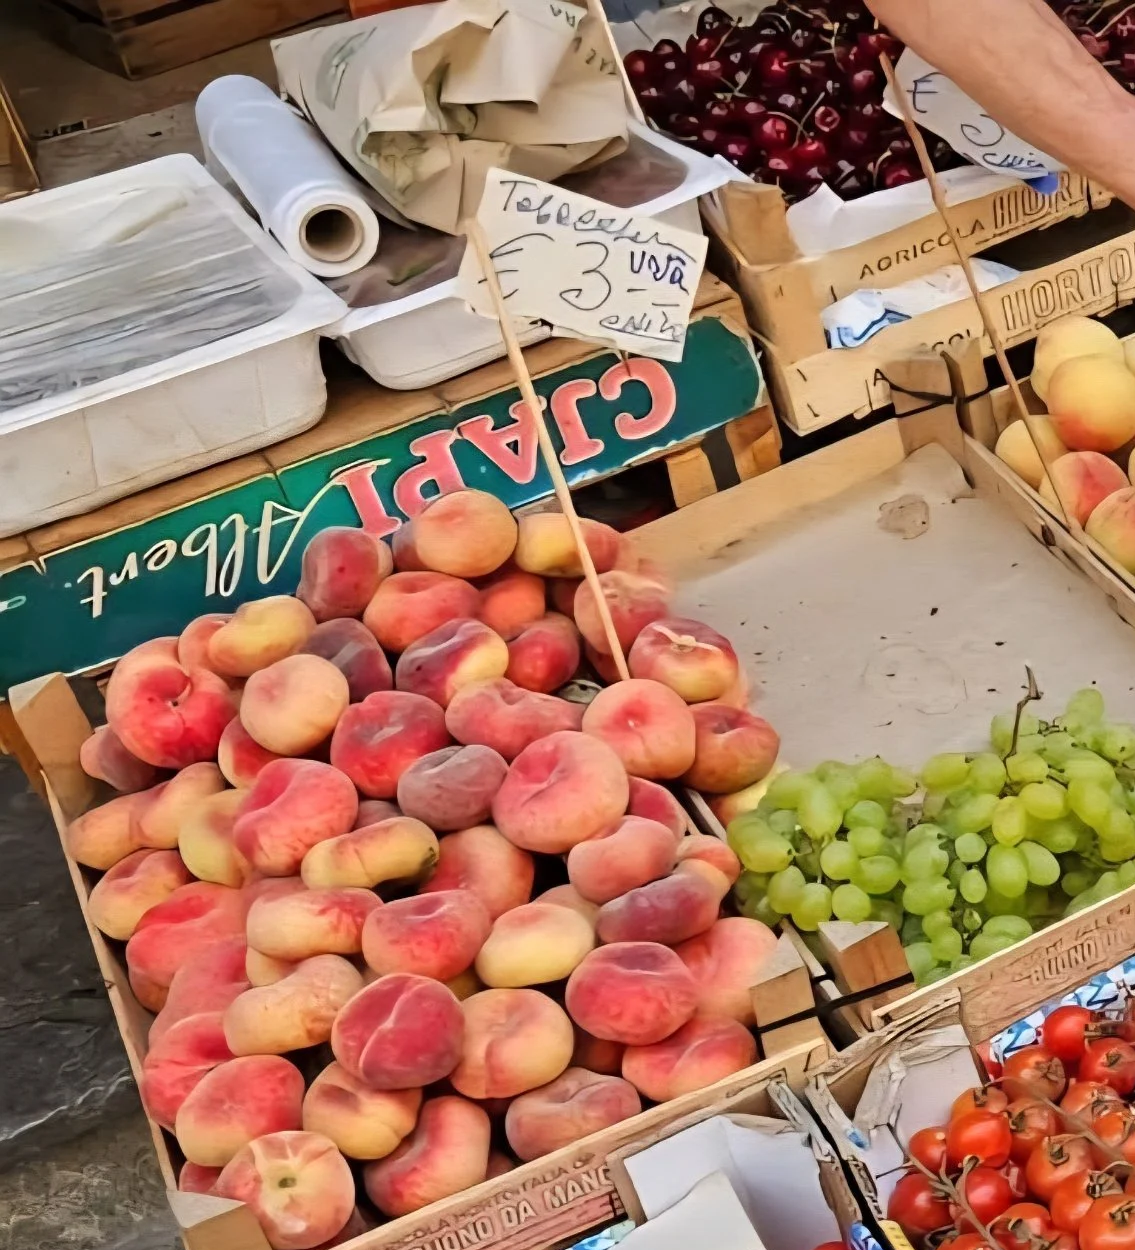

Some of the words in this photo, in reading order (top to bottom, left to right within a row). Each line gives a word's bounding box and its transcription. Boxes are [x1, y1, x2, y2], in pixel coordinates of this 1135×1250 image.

[560, 241, 611, 311] 3
[336, 357, 677, 537] CJAPI
[500, 1201, 537, 1228] DA
